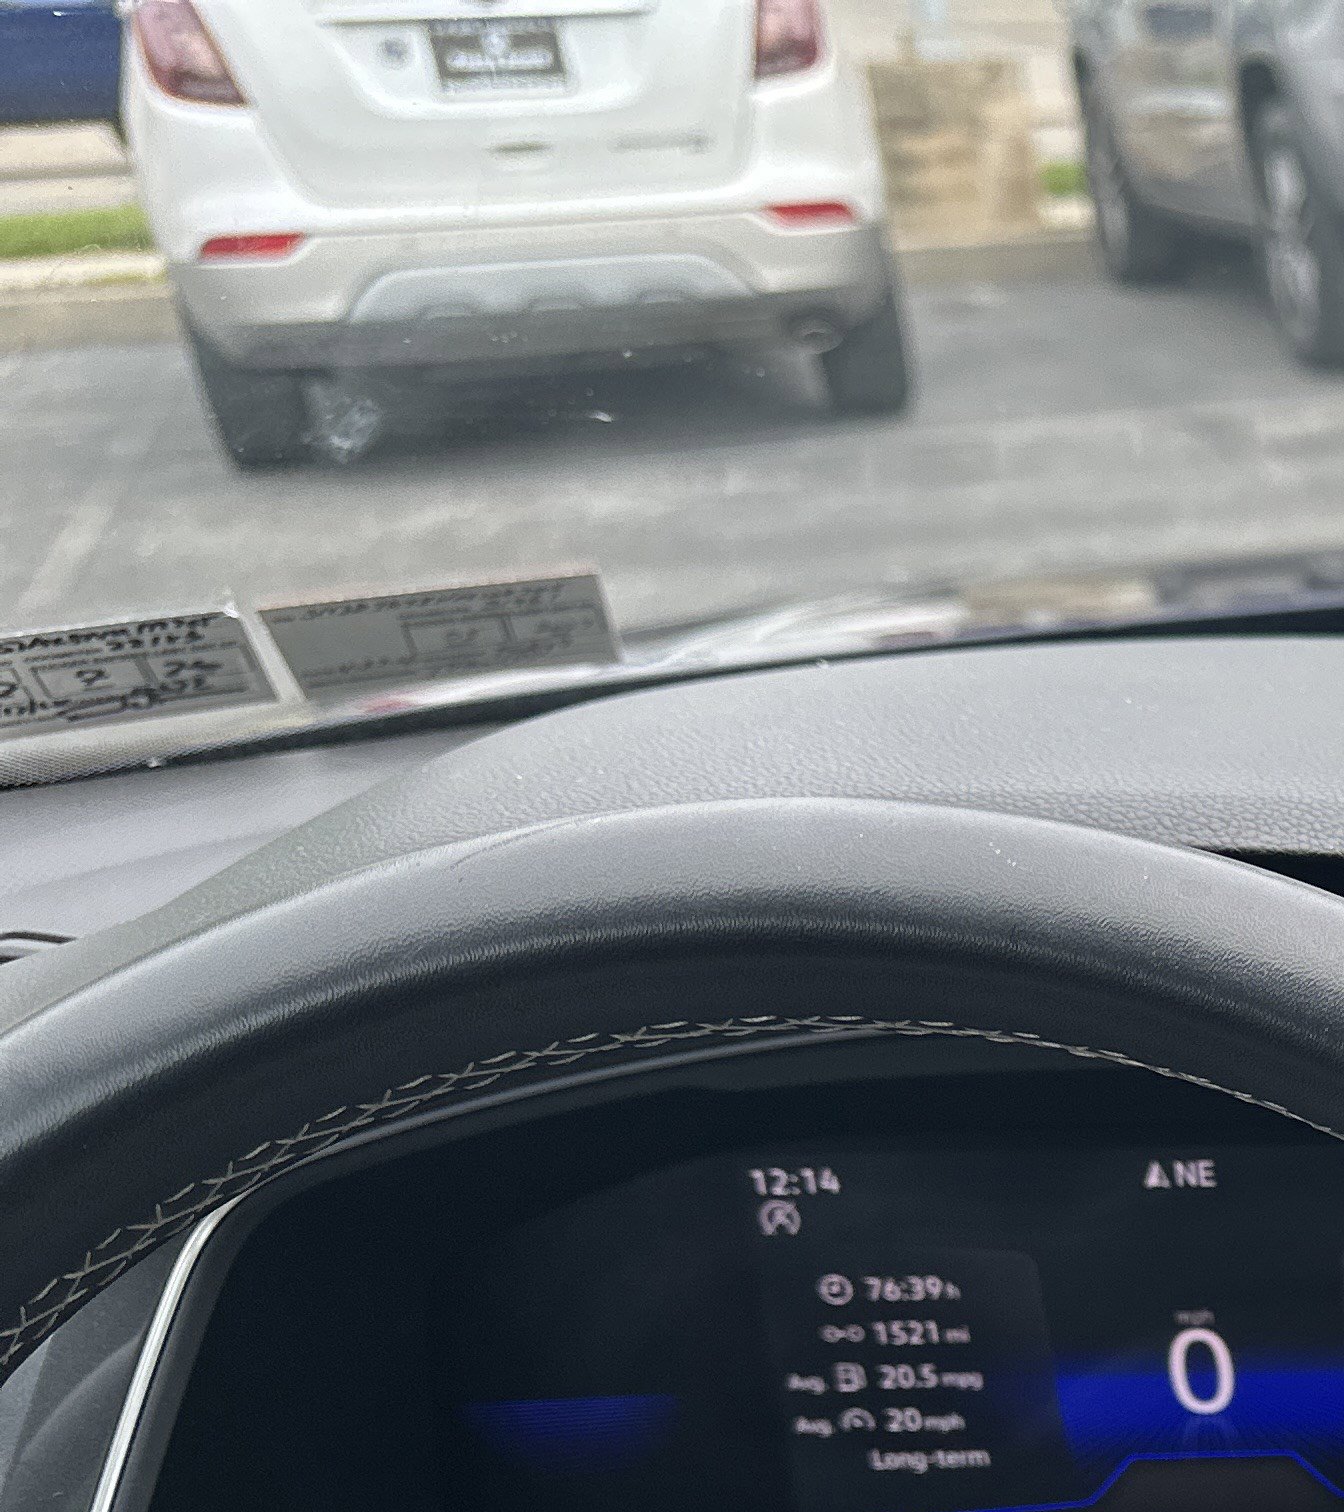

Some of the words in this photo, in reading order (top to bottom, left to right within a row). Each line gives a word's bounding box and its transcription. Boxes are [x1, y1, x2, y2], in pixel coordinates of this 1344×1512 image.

[748, 1167, 842, 1195] 12:14
[1172, 1159, 1218, 1188] NE
[1167, 1328, 1236, 1416] 0
